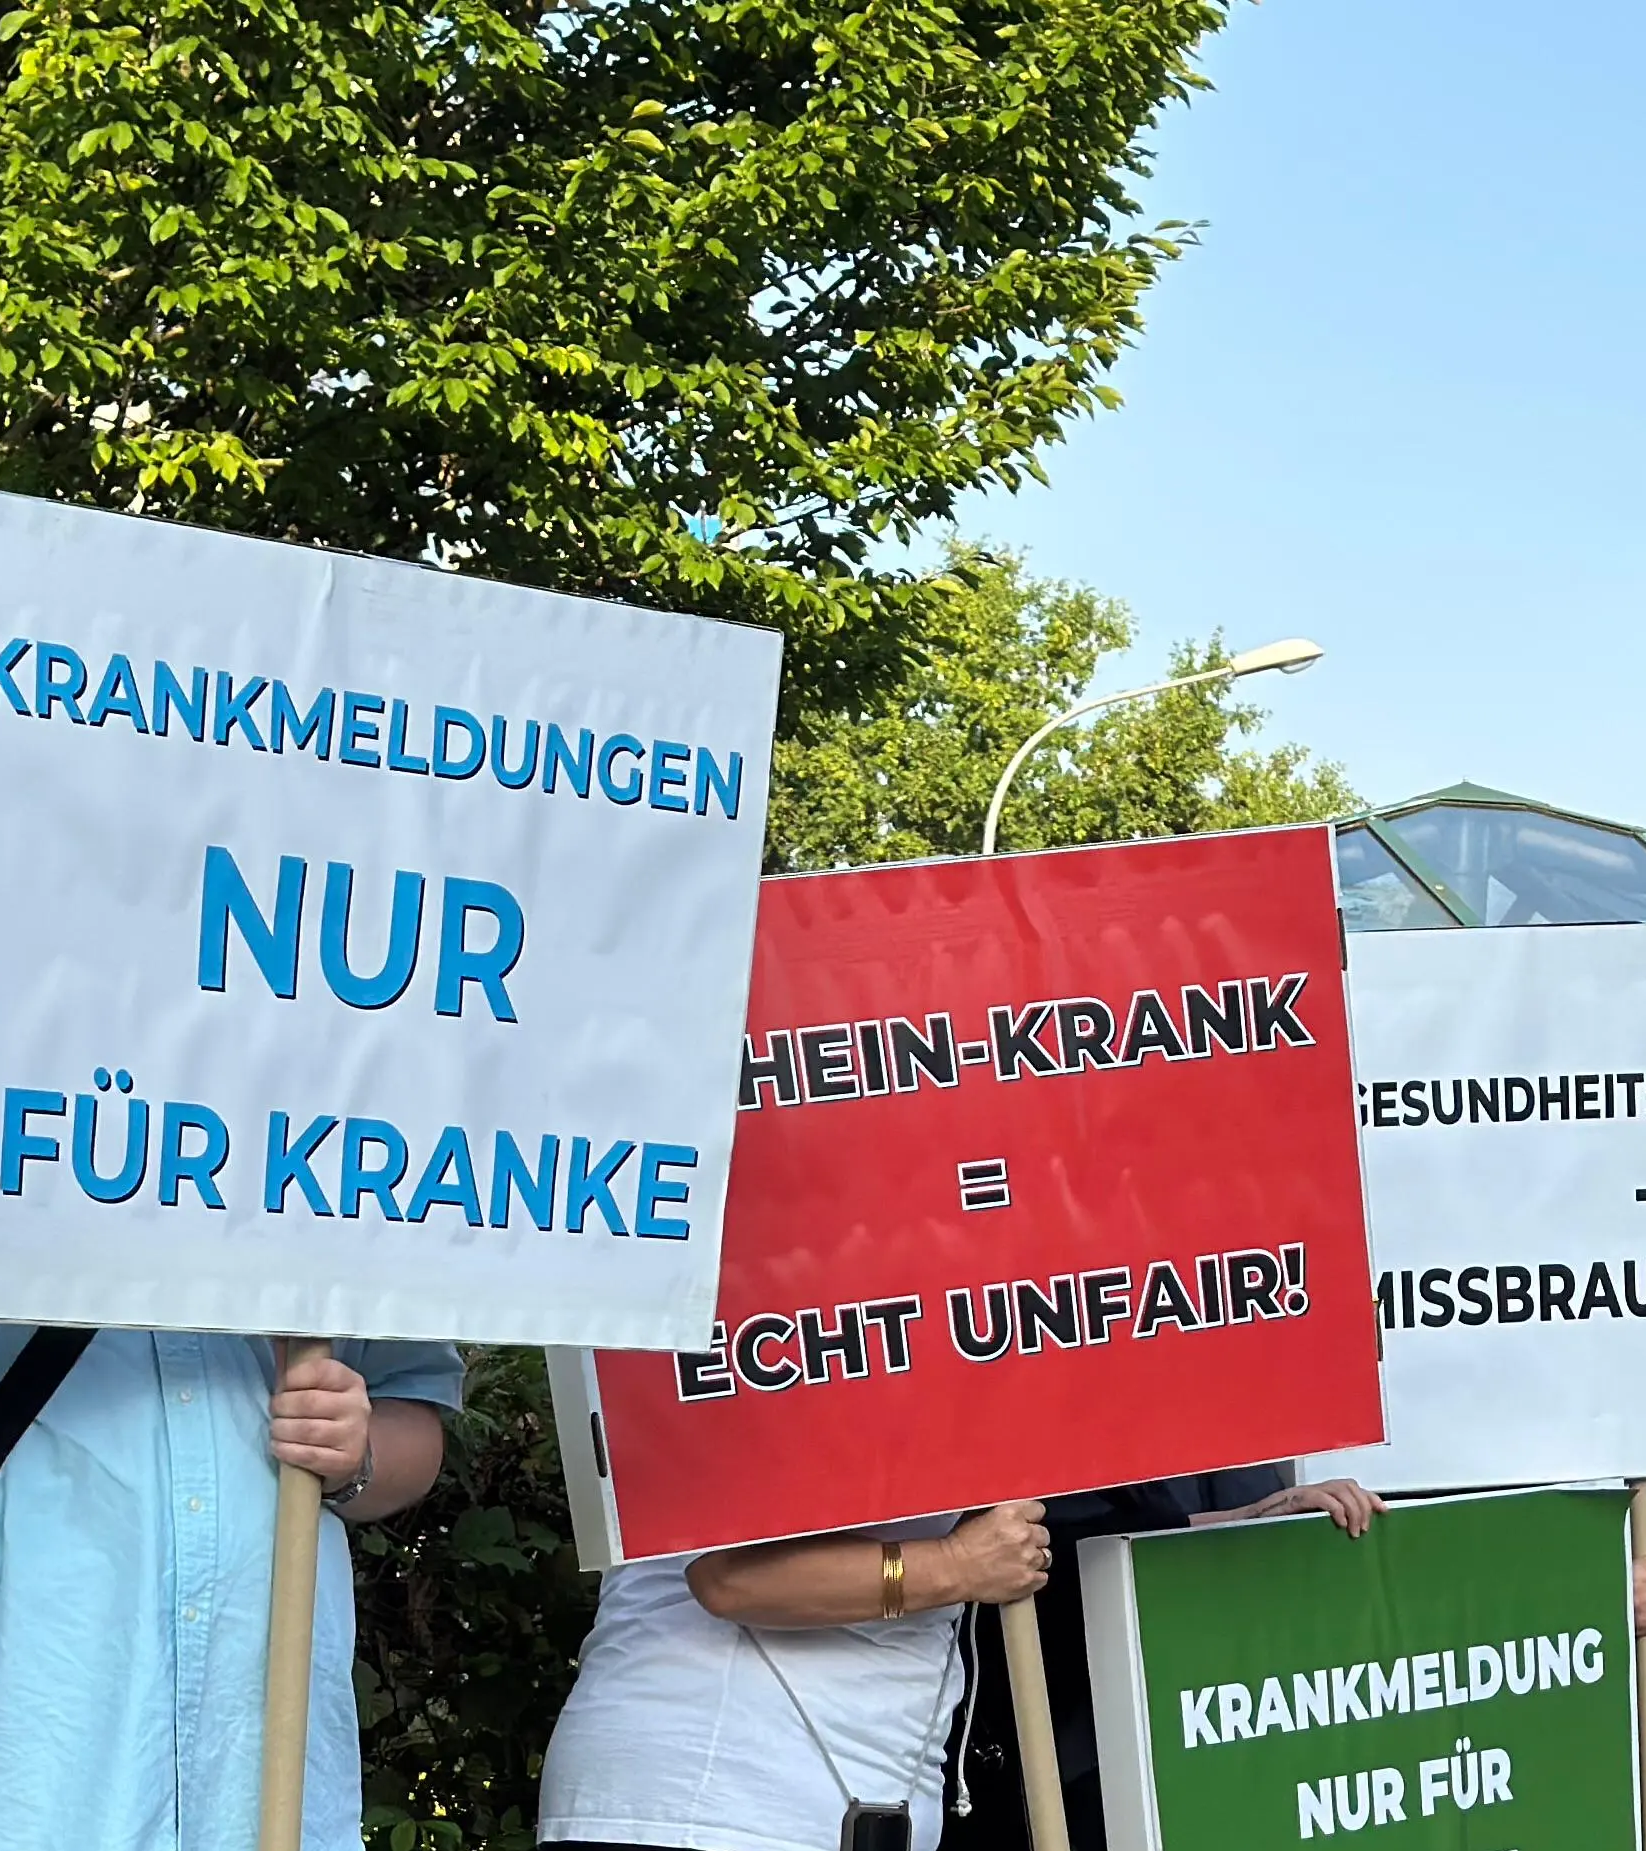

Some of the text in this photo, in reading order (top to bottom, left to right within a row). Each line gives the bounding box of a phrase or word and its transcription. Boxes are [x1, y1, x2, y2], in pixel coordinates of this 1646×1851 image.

[197, 846, 526, 1024] NUR
[0, 1066, 699, 1241] FÜR KRANKE
[674, 1243, 1310, 1402] ECHT UNFAIR!
[1180, 1628, 1604, 1748] KRANKMELDUNG
[1297, 1737, 1513, 1839] NUR FÜR
